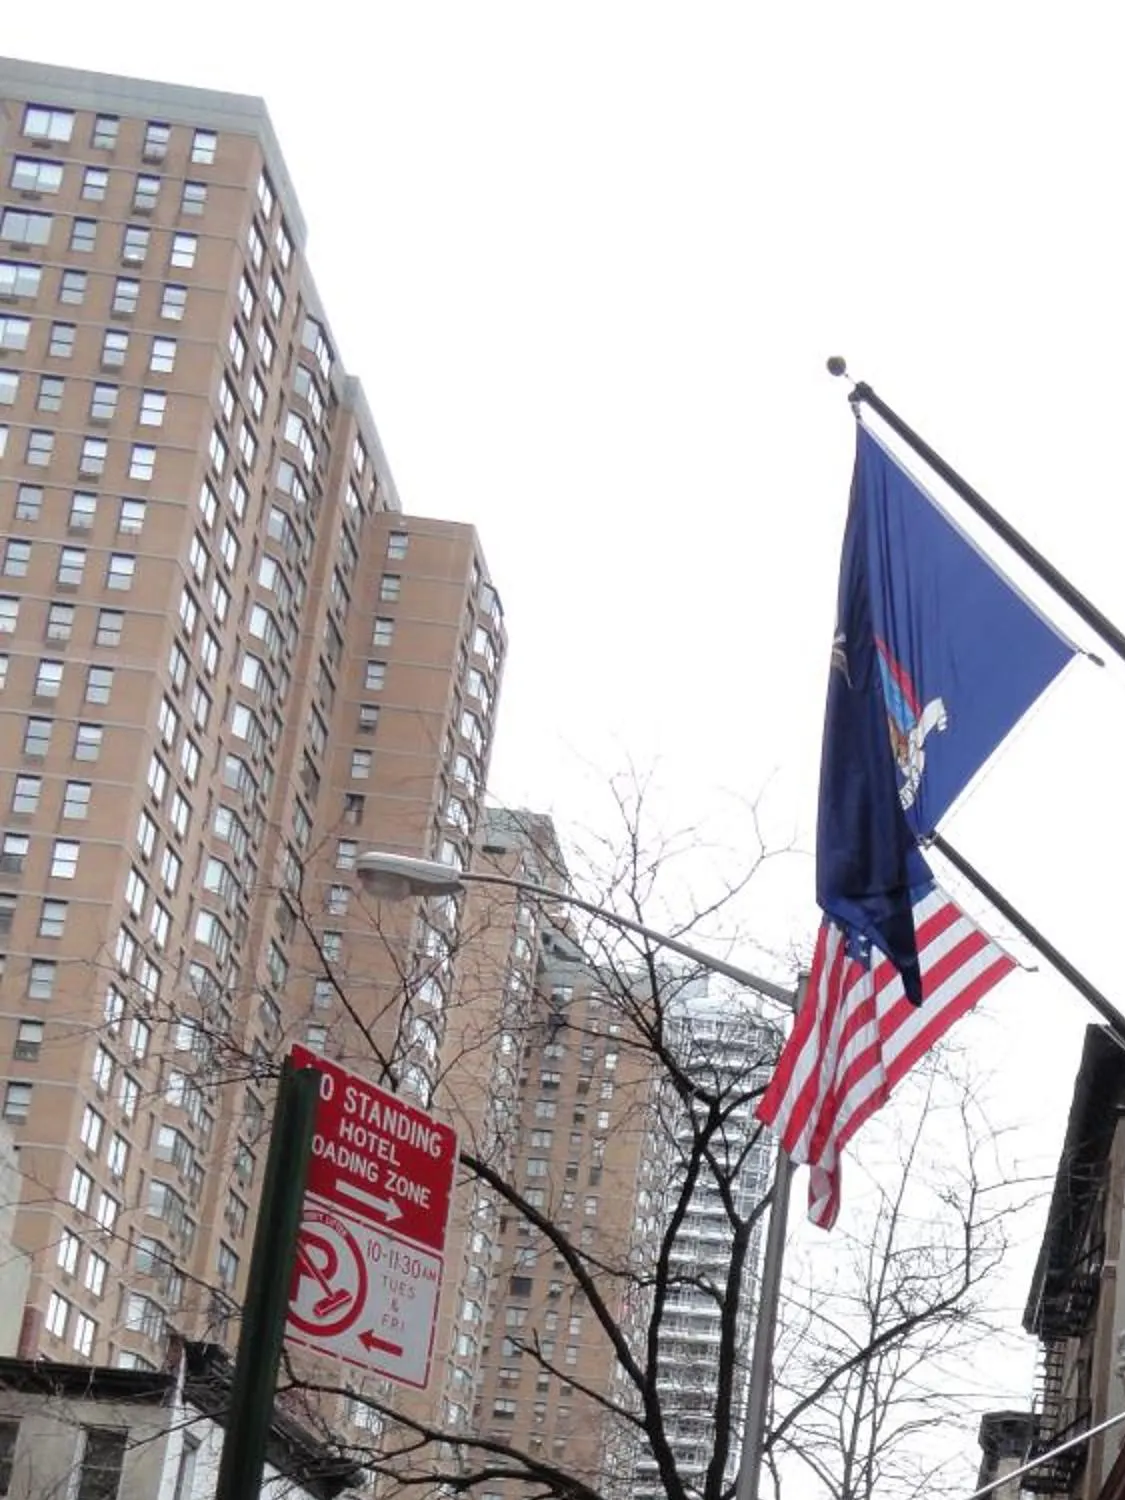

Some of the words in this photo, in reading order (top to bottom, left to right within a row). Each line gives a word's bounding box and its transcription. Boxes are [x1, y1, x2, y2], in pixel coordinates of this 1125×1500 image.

[319, 1073, 334, 1101] O
[344, 1087, 442, 1158] STANDING
[339, 1118, 400, 1167] HOTEL
[311, 1134, 379, 1183] OADING
[384, 1170, 431, 1210] ZONE
[383, 1275, 416, 1300] TUES
[382, 1313, 405, 1330] FRI
